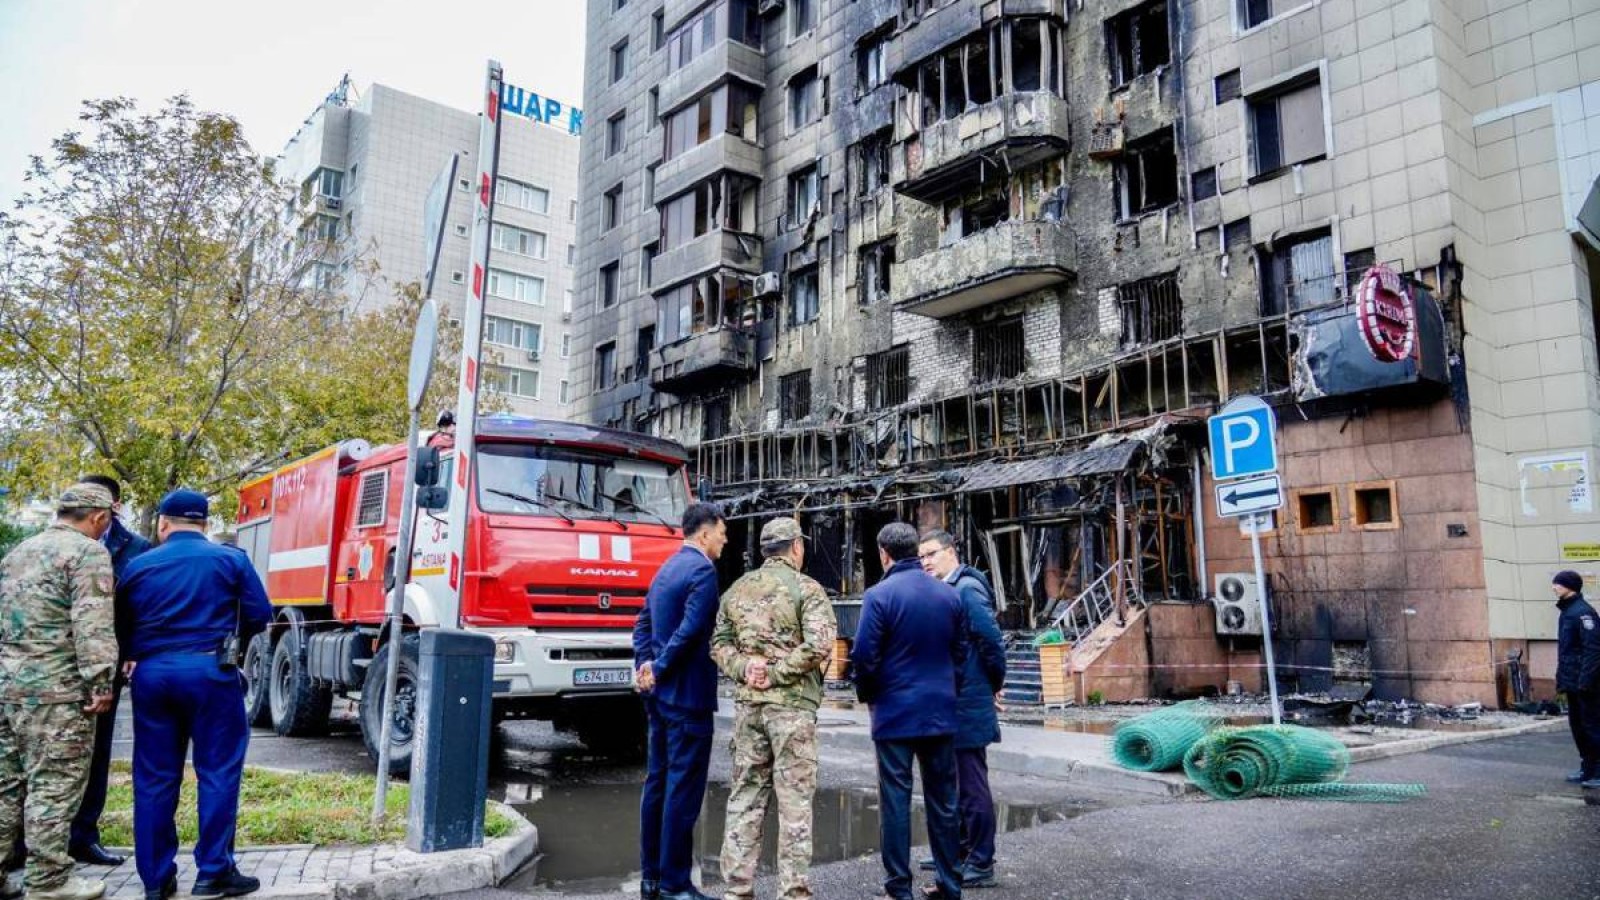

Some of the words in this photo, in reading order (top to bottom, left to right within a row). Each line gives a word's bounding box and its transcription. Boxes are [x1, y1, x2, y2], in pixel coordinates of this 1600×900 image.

[1222, 416, 1260, 473] P
[432, 519, 441, 543] 3
[569, 567, 639, 577] KAMAZ
